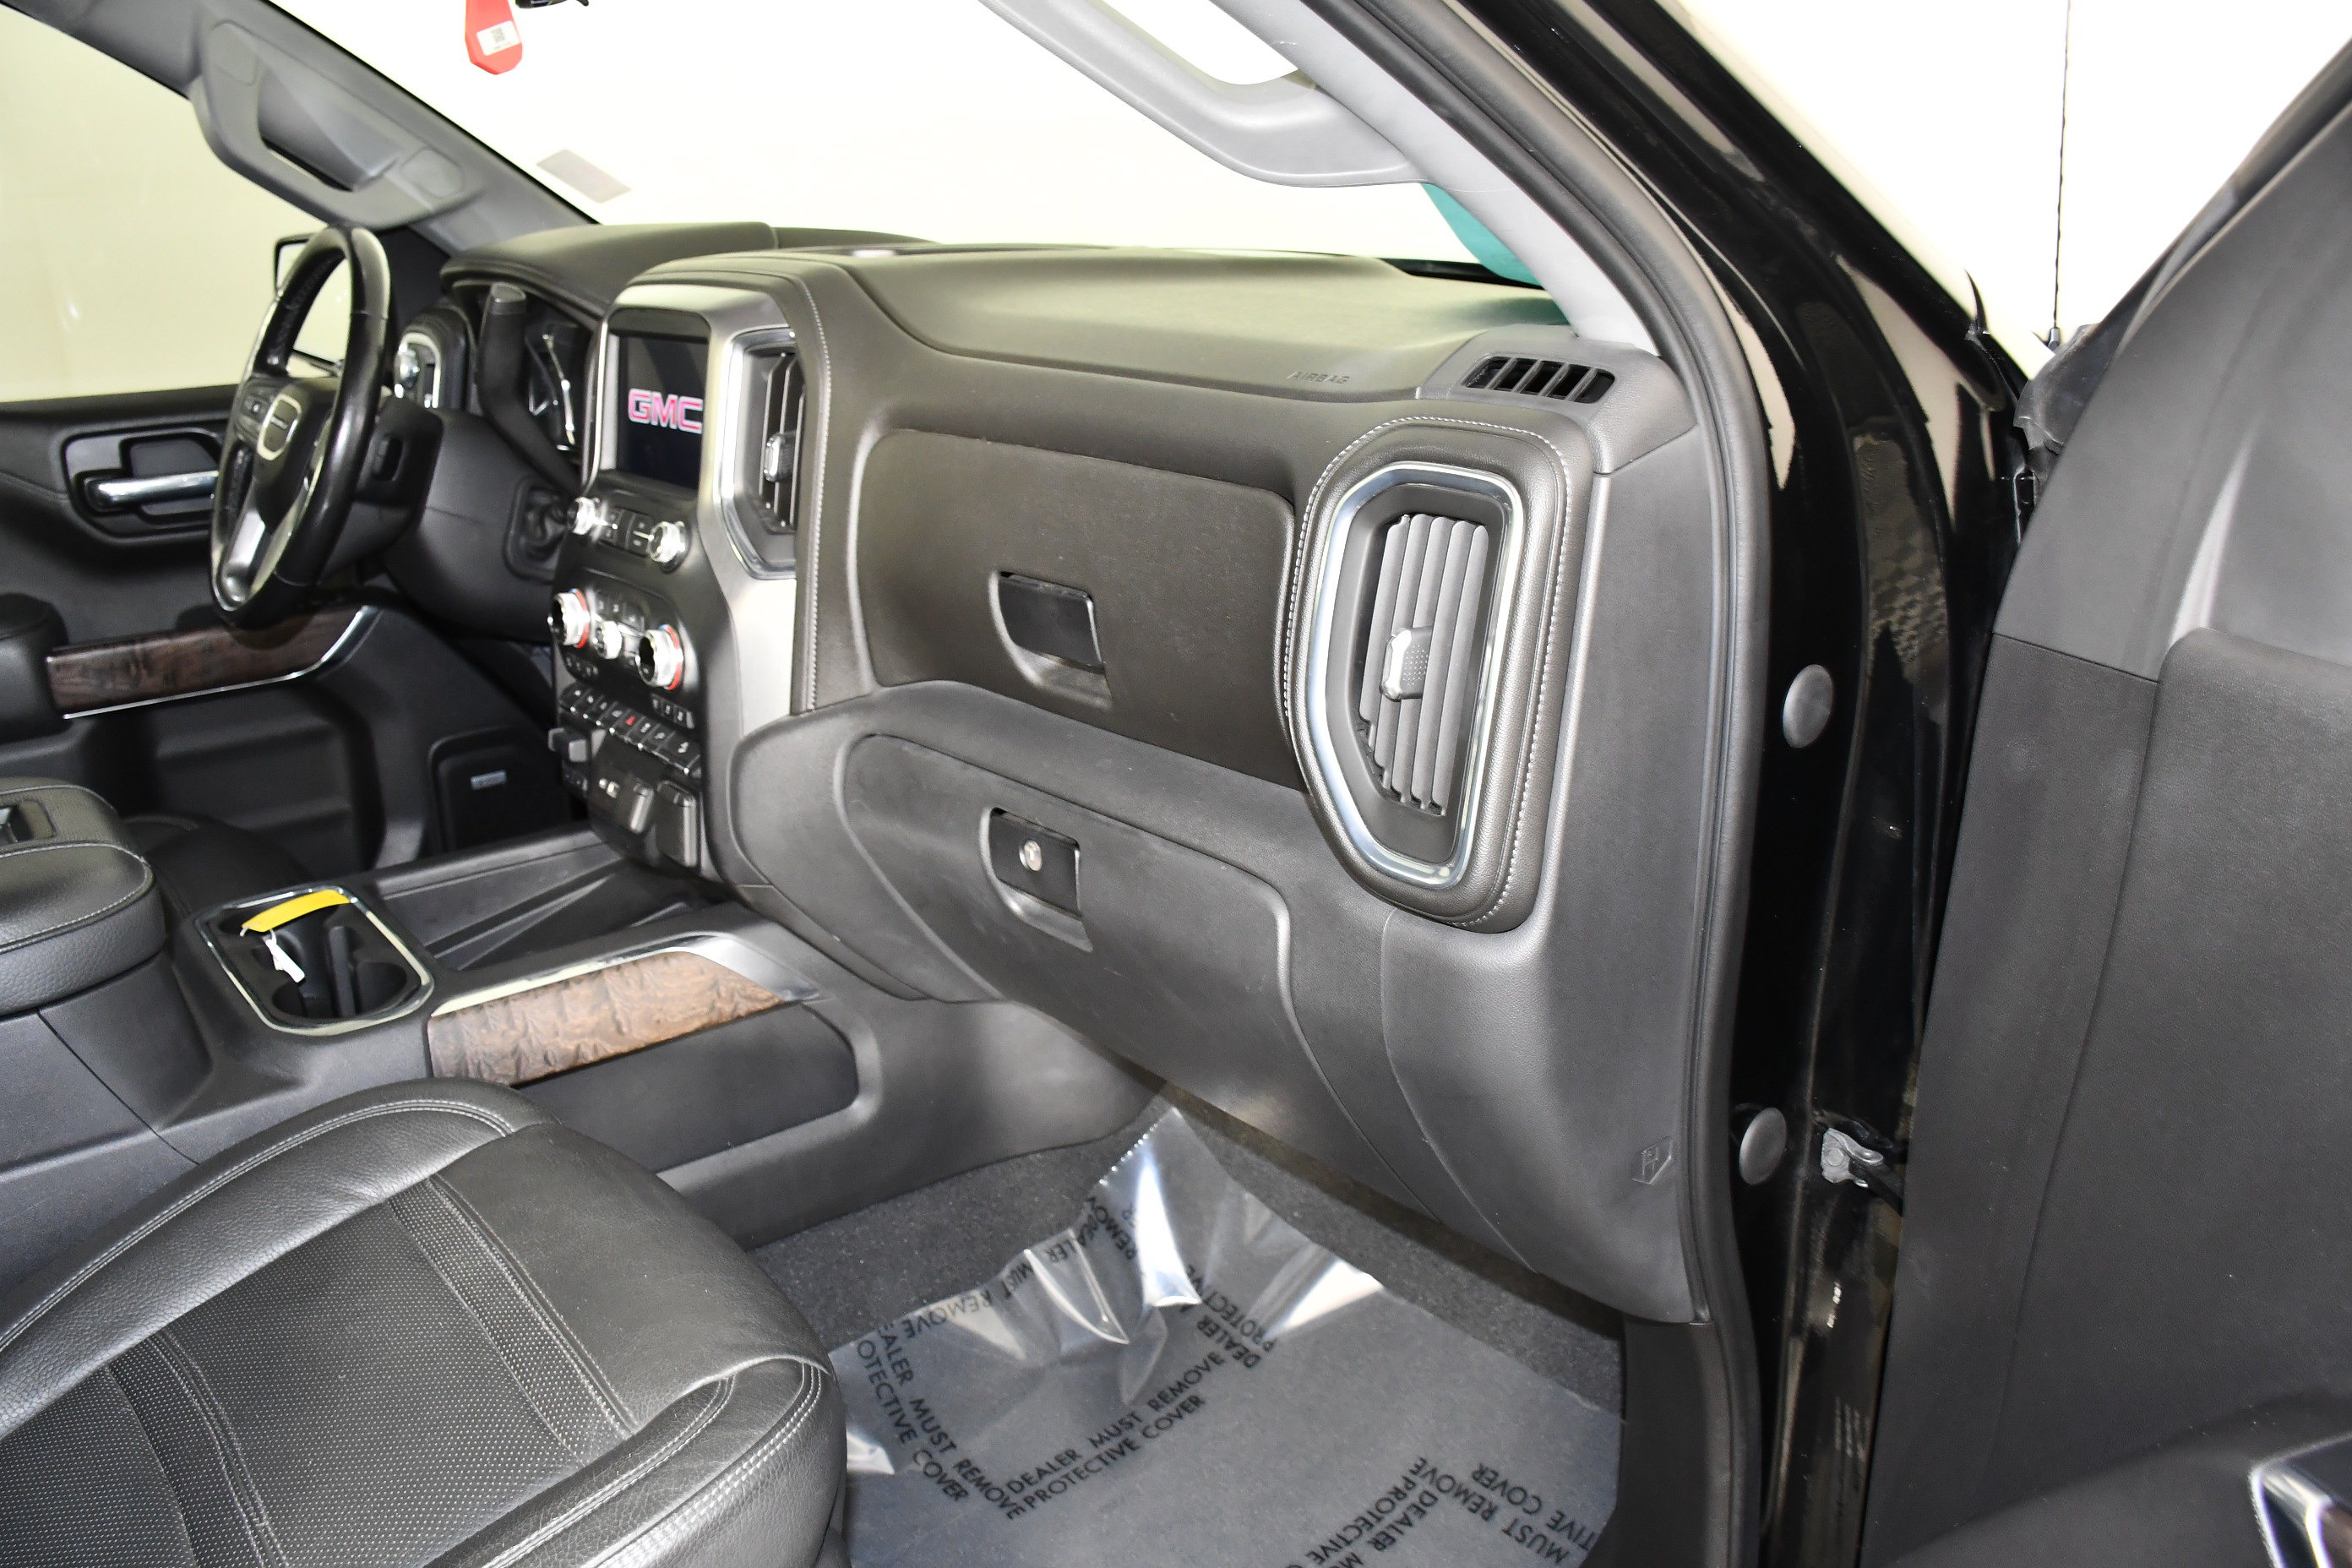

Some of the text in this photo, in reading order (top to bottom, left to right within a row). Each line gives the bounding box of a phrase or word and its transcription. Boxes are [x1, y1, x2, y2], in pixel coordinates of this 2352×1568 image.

[628, 388, 704, 435] GMC
[901, 1288, 994, 1339] REMOVE
[1195, 1314, 1261, 1369] DEALER
[857, 1339, 970, 1502] OTECTIVE COVER
[909, 1398, 958, 1454] MUST
[952, 1457, 1026, 1520] REMOVE
[1006, 1352, 1225, 1494] DEALER MUST REMOVE
[1023, 1394, 1206, 1510] PROTECTIVE COVER
[1305, 1474, 1417, 1565] PROTECTIVE
[1366, 1489, 1440, 1552] DEALER
[1408, 1456, 1571, 1565] MUST REMOVE
[1470, 1462, 1543, 1515] COVER
